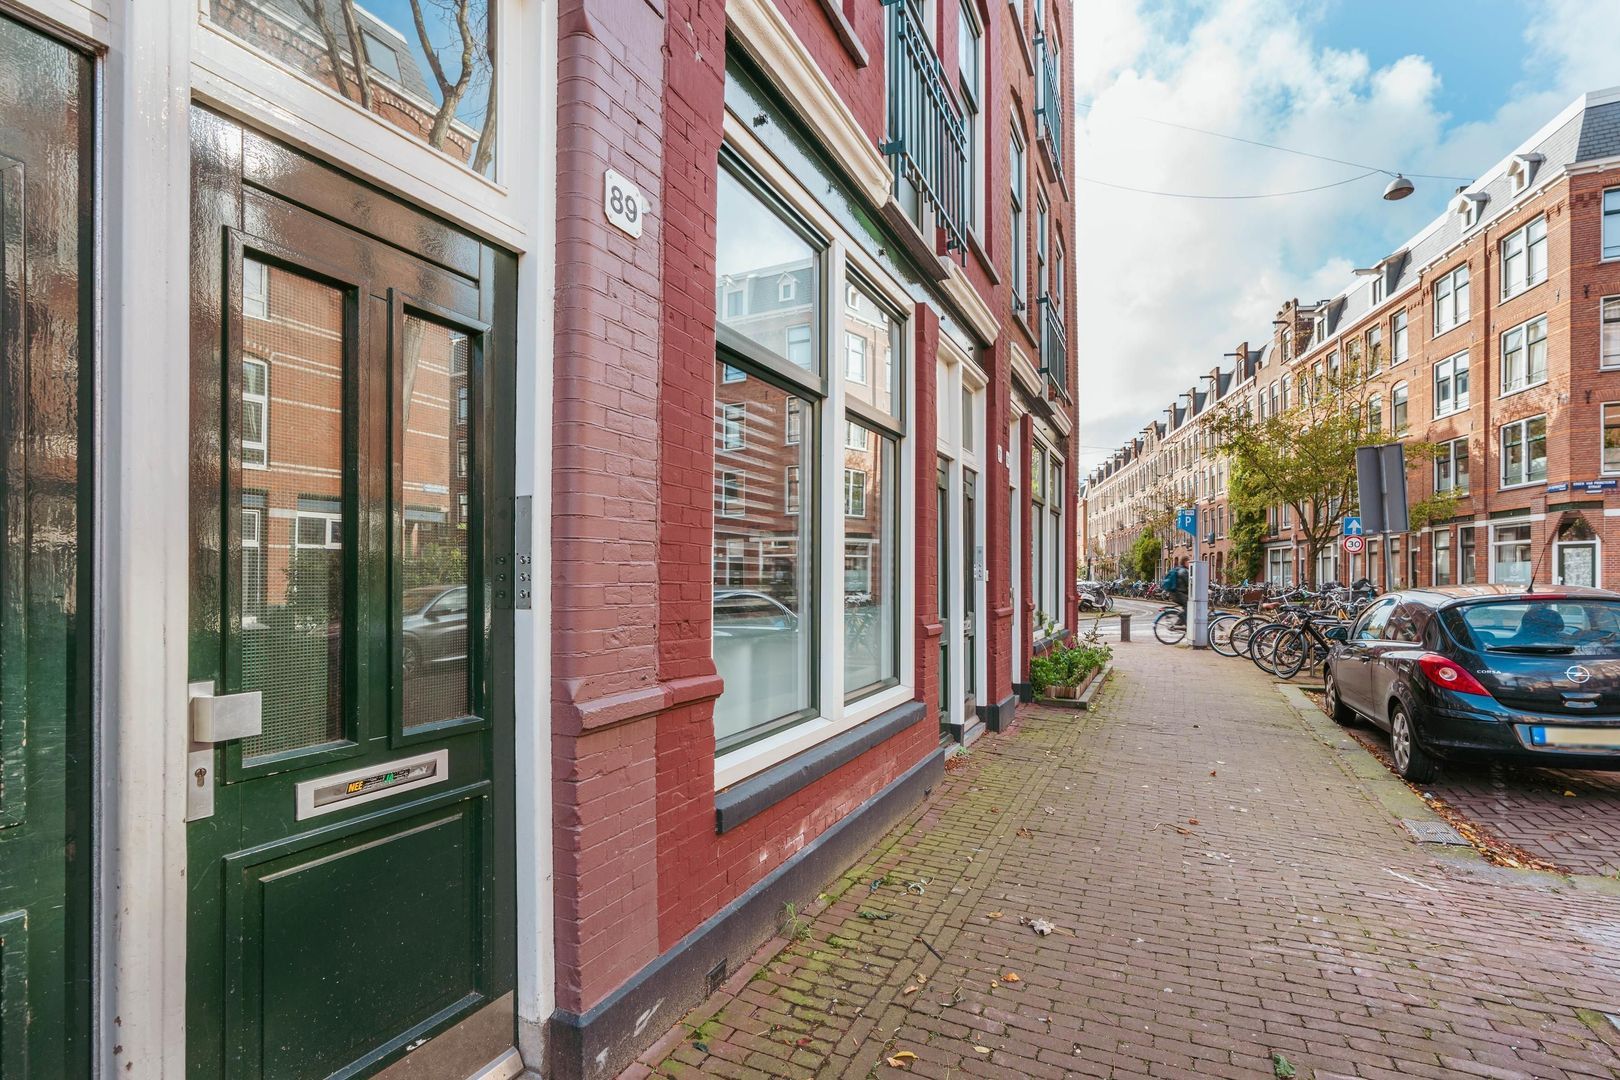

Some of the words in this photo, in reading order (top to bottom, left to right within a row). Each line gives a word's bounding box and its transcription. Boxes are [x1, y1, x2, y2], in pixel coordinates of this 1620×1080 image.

[610, 185, 638, 223] 89
[1185, 516, 1192, 527] P
[1348, 540, 1361, 548] 30
[347, 780, 365, 793] NEE
